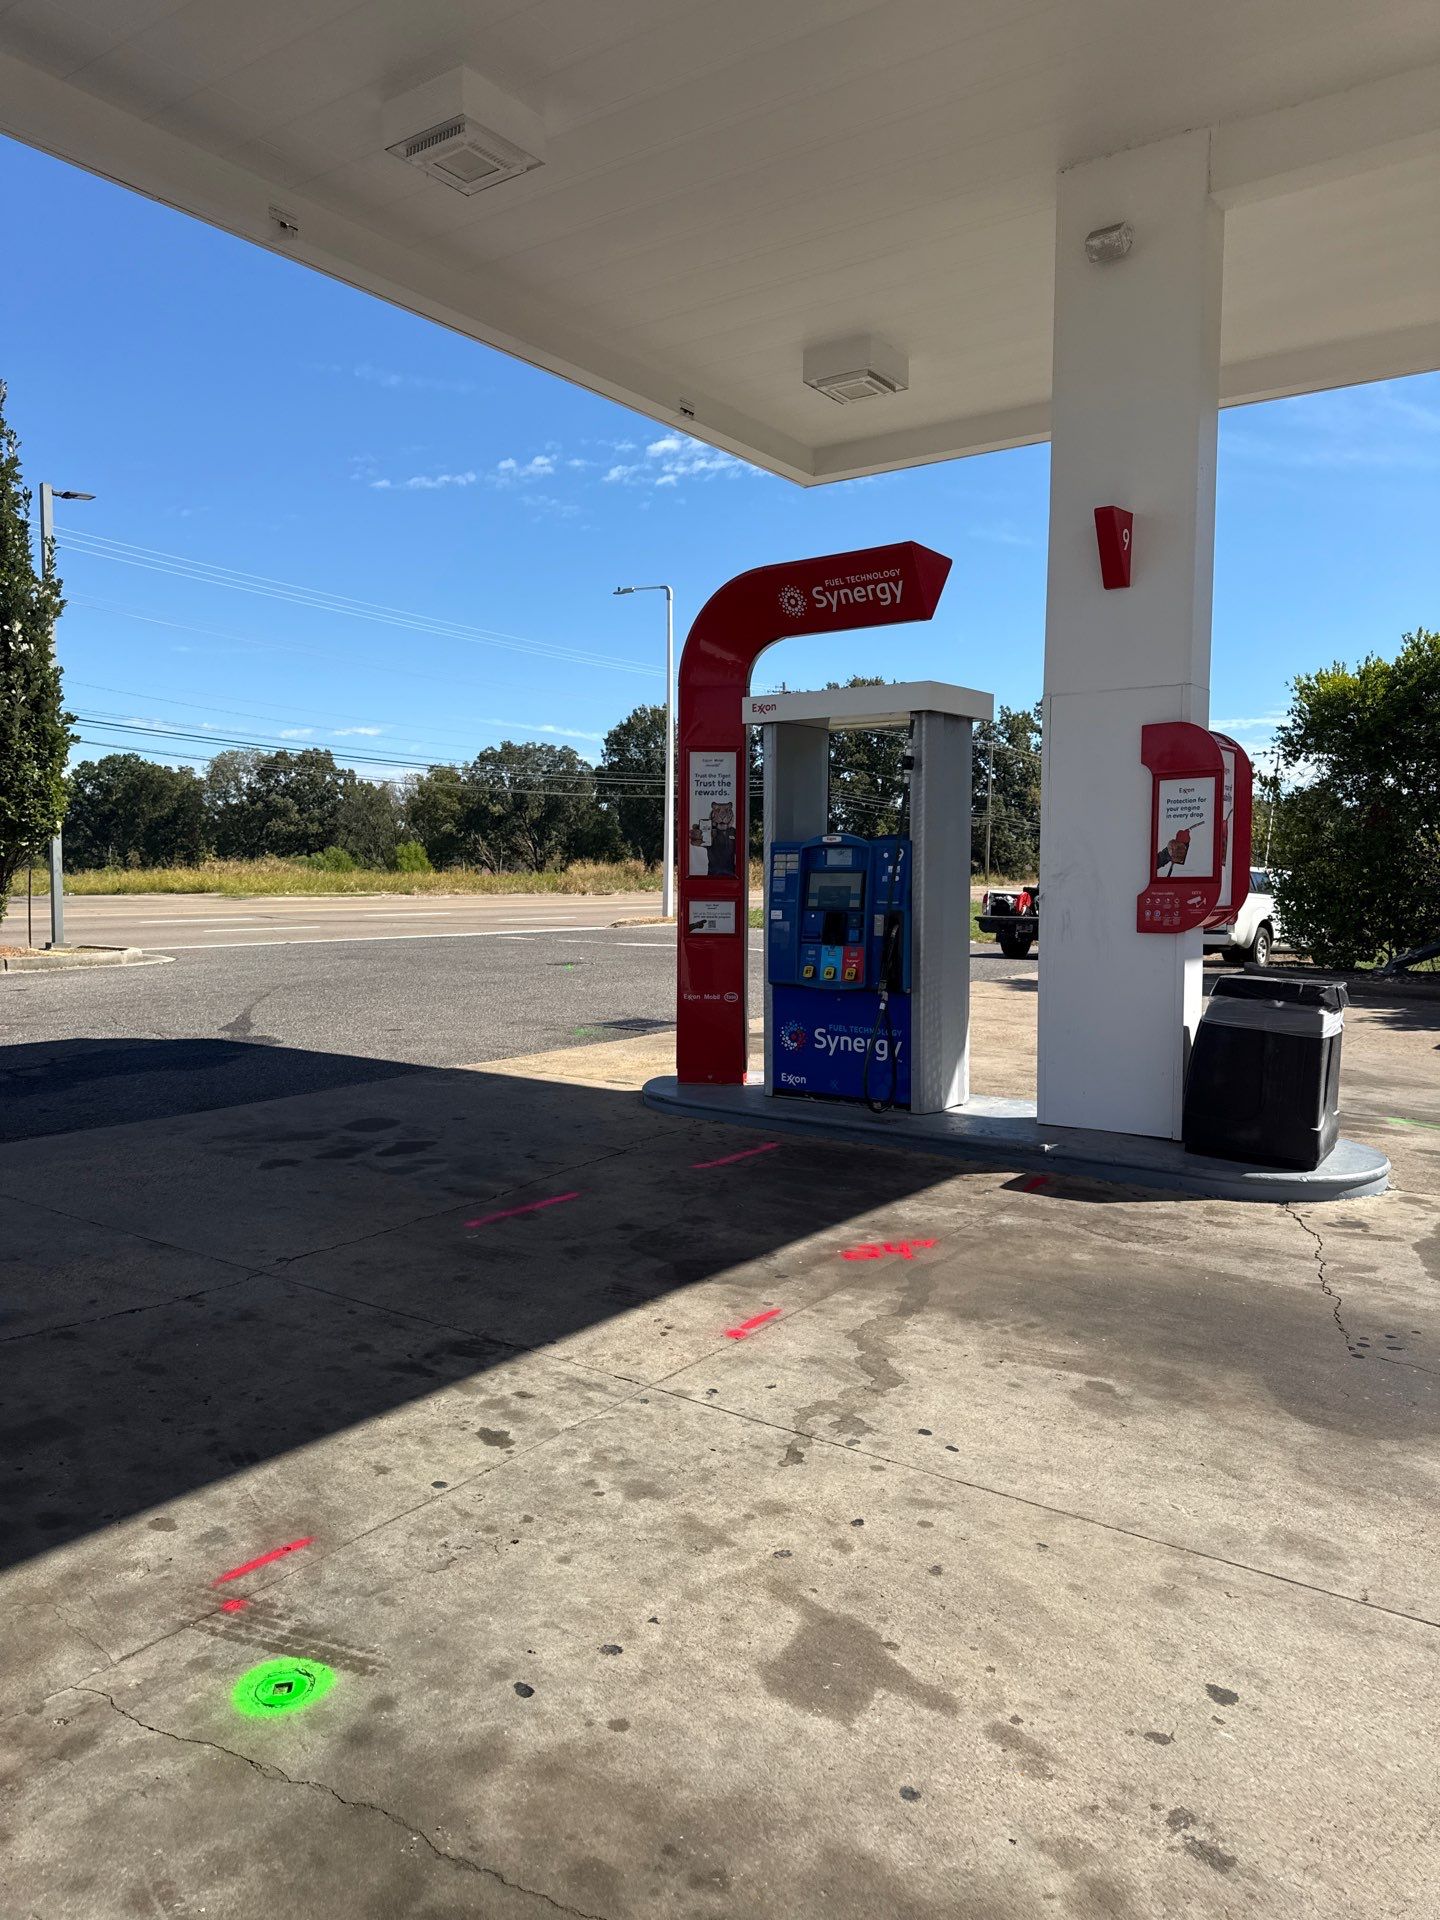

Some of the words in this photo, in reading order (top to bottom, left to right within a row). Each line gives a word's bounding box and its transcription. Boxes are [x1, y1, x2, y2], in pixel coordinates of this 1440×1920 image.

[1122, 528, 1130, 551] 9
[825, 577, 845, 587] FUEL
[845, 568, 901, 584] TECHNOLOGY
[812, 580, 903, 612] Synergy
[752, 703, 777, 714] Exxon
[694, 779, 716, 787] Trust
[717, 779, 731, 787] the
[694, 788, 730, 796] rewards.
[683, 993, 701, 1001] Exxon
[829, 1024, 847, 1033] FUEL
[850, 1025, 902, 1037] TECHNOLGY
[781, 1073, 807, 1086] Exxon
